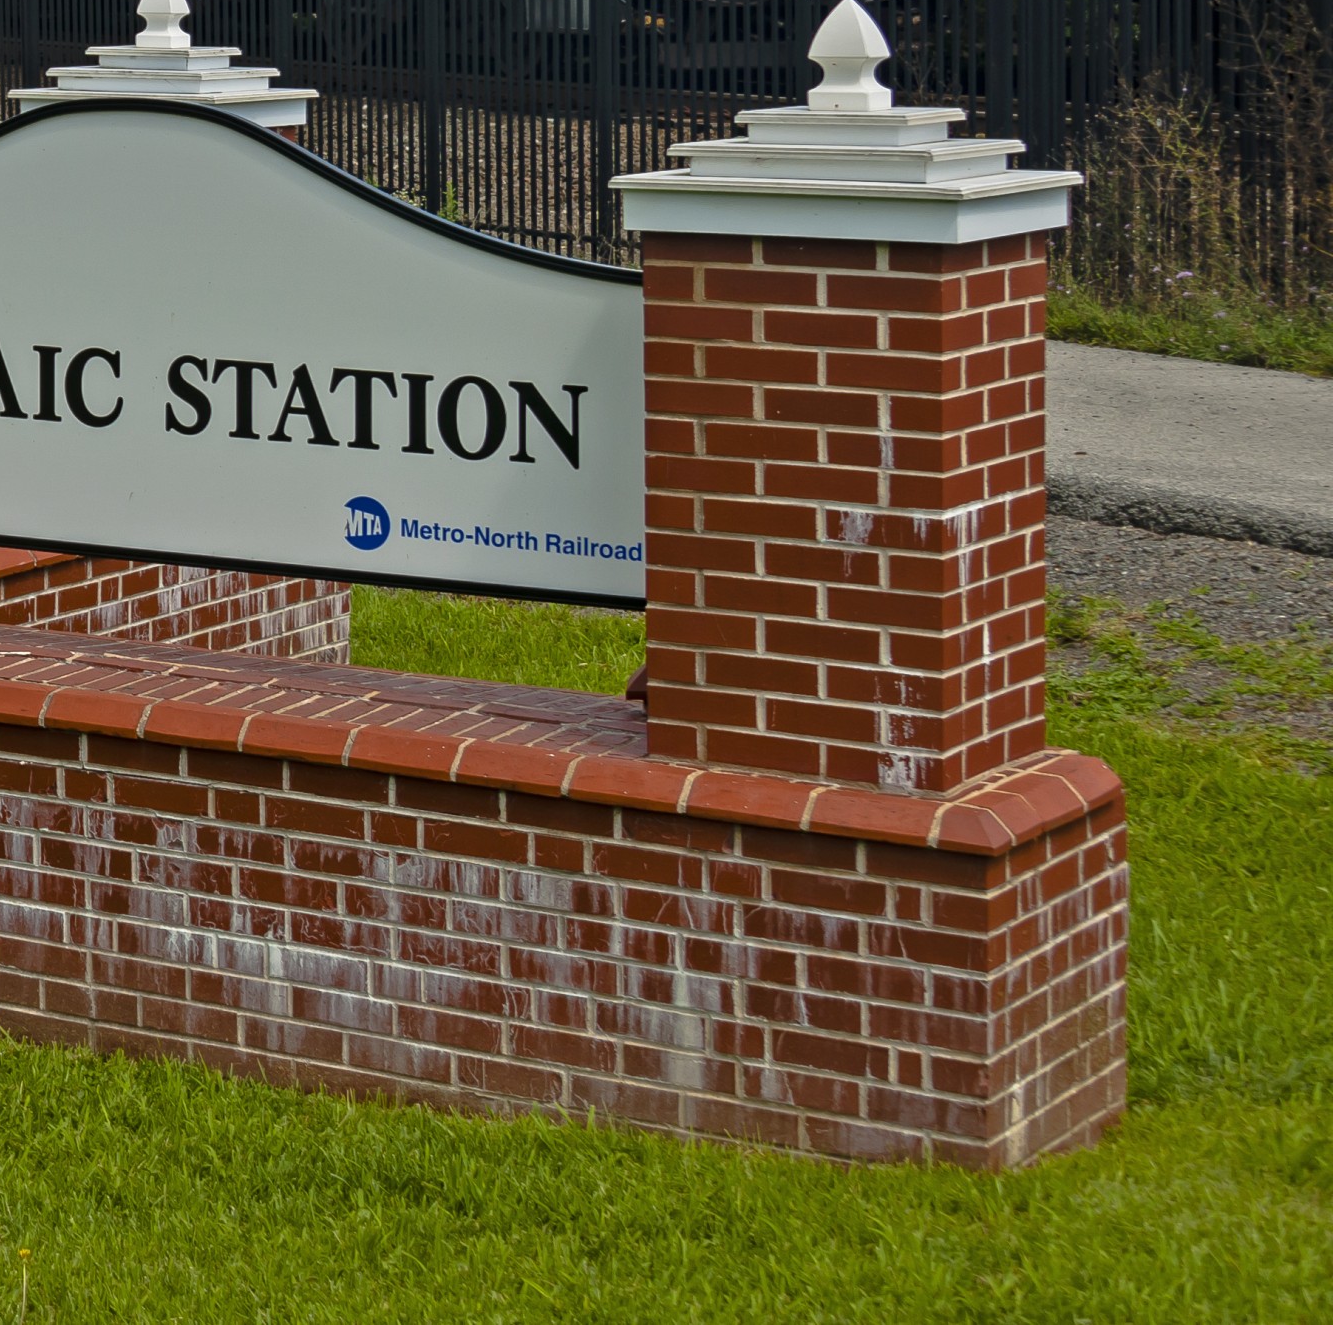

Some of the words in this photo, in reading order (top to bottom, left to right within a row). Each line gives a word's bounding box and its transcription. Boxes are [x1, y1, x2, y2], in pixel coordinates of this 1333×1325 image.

[165, 355, 589, 470] STATION
[401, 518, 538, 551] Metro-North
[545, 533, 642, 562] Railroad
